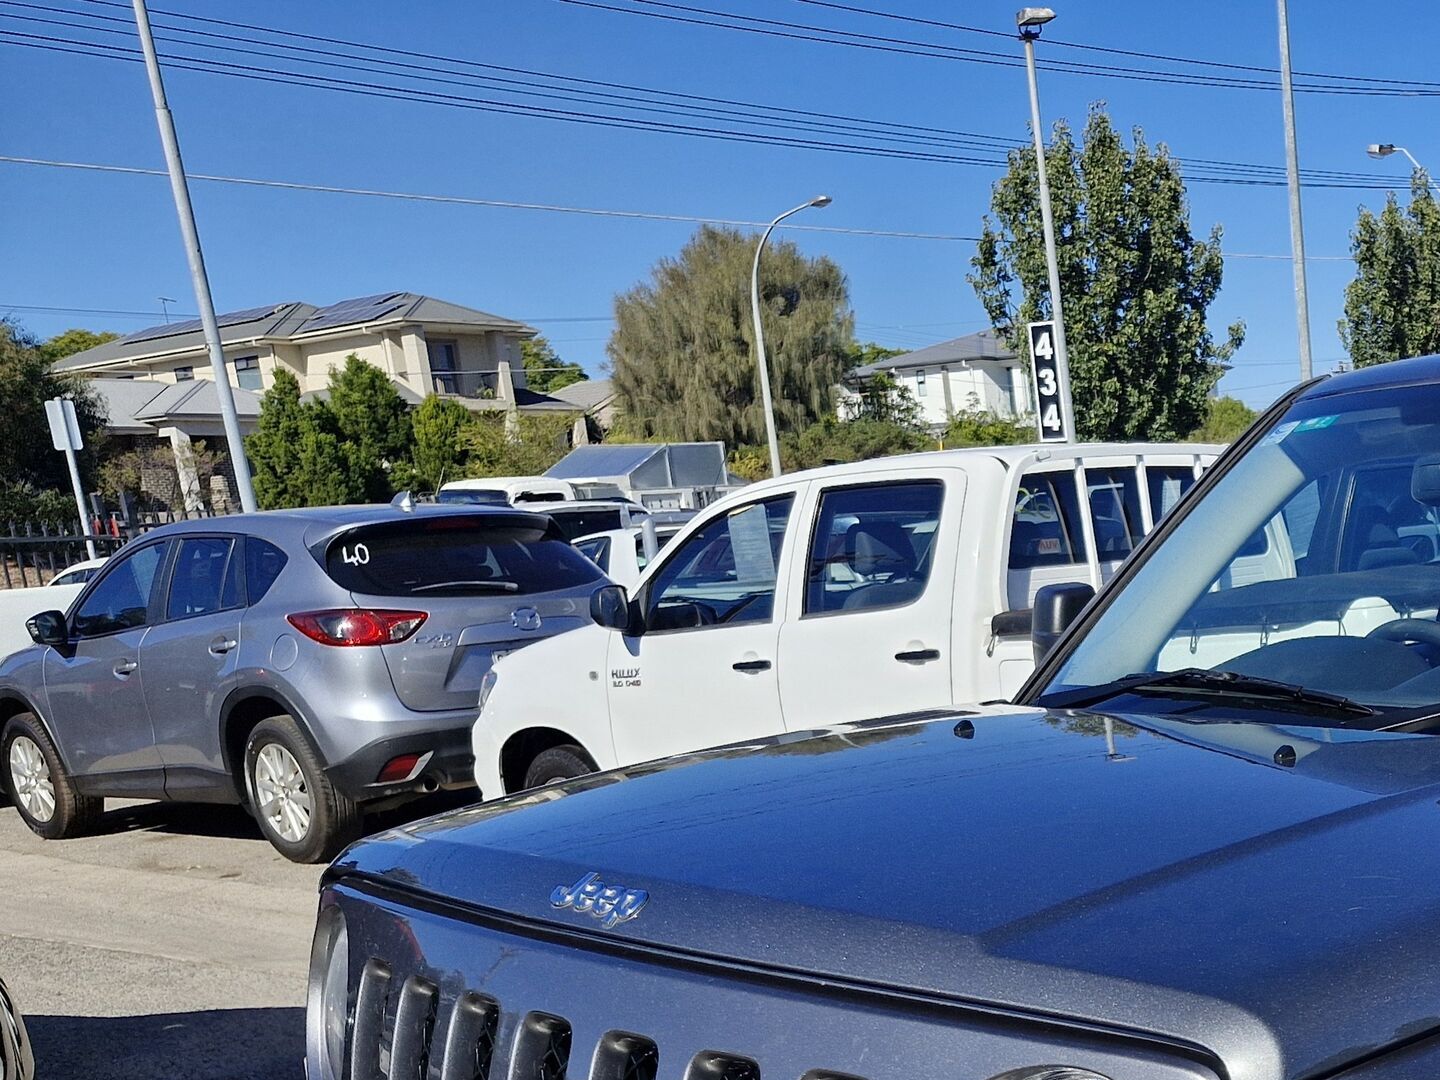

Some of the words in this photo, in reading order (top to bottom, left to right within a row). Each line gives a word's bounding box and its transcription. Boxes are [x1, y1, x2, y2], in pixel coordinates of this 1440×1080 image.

[1035, 332, 1061, 432] 434
[342, 543, 370, 567] 40
[611, 667, 641, 679] HILUX
[550, 871, 650, 930] Jeep
